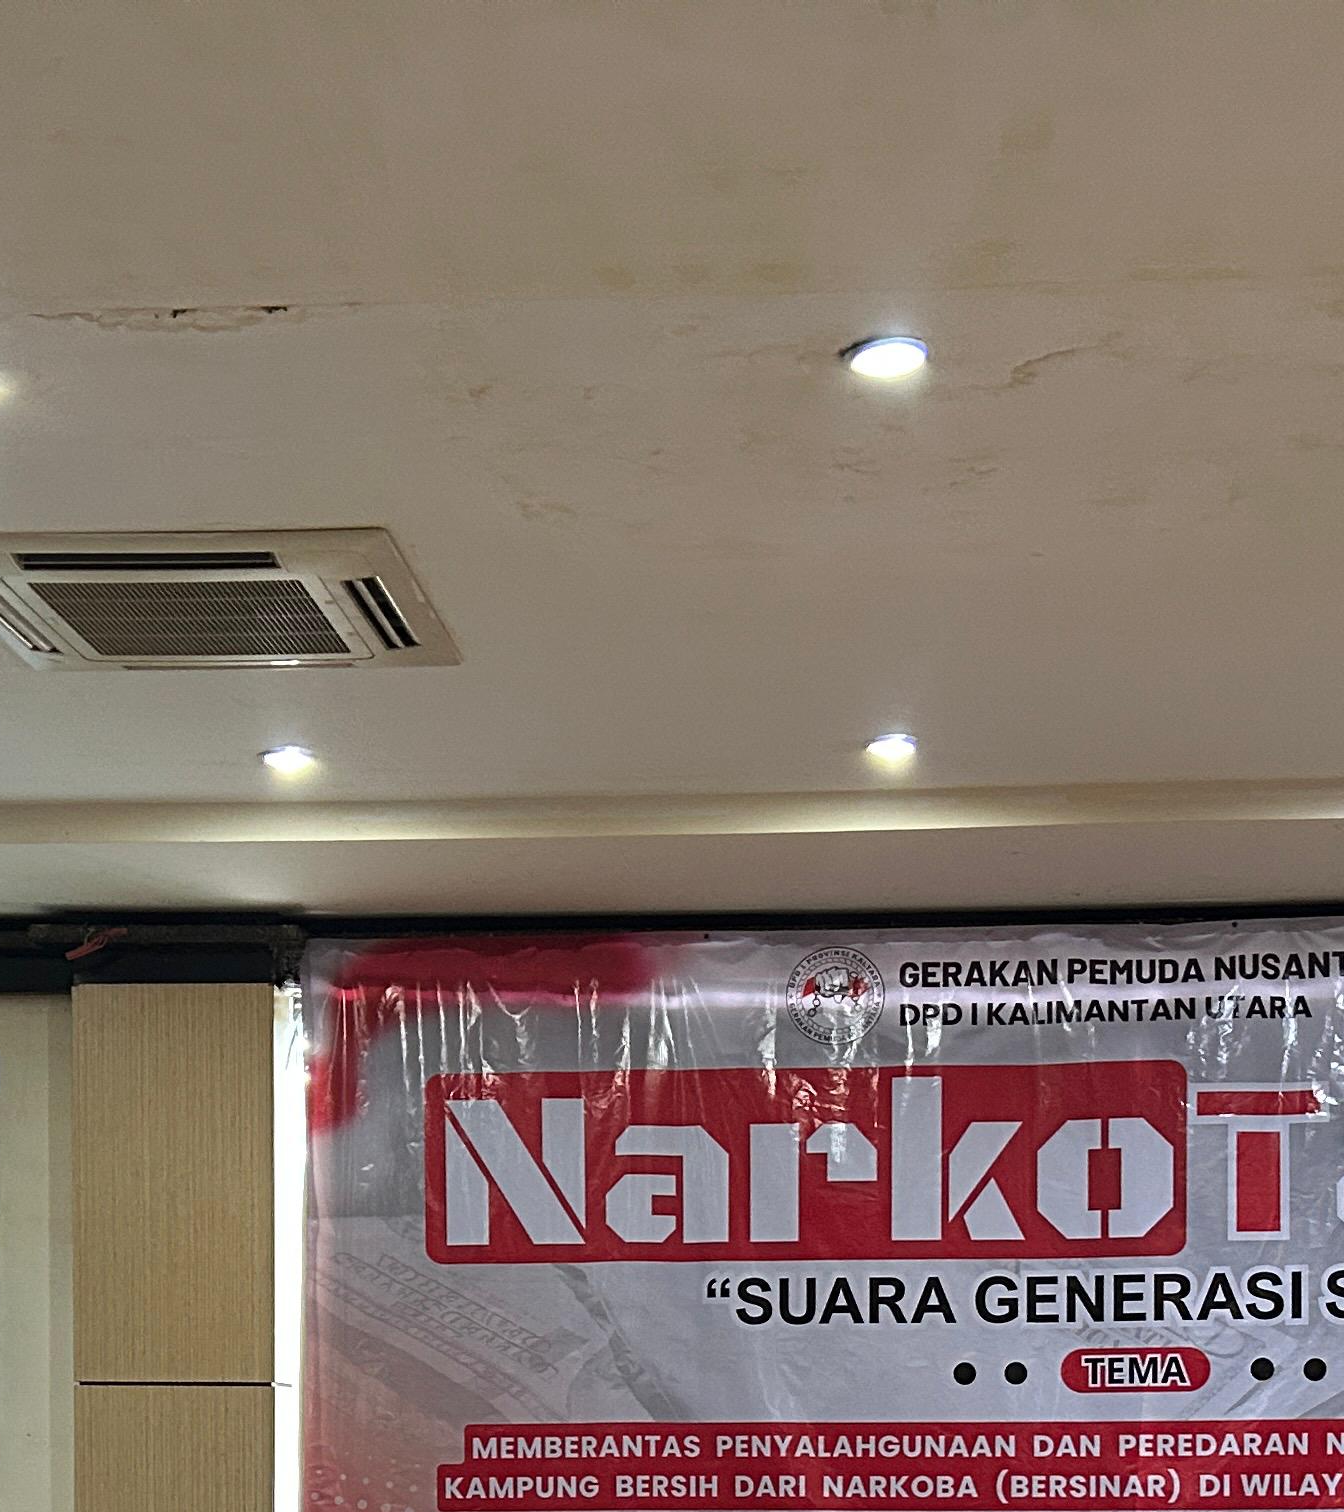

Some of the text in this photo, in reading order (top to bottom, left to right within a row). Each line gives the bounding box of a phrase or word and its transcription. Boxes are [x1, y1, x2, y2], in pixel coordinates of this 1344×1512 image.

[899, 959, 1058, 987] GERAKAN
[1067, 957, 1205, 985] PEMUDA
[899, 1003, 963, 1027] DPD
[971, 1003, 978, 1026] I
[987, 997, 1196, 1026] KALIMANTAN
[1206, 995, 1312, 1020] UTARA
[706, 1275, 957, 1325] “SUARA
[974, 1269, 1303, 1324] GENERASI
[1083, 1354, 1189, 1386] TEMA
[471, 1434, 701, 1460] MEMBERANTAS
[716, 1434, 1016, 1459] PENYALAHGUNAAN
[1033, 1434, 1101, 1458] DAN
[1118, 1433, 1309, 1458] PEREDARAN
[444, 1475, 600, 1500] KAMPUNG
[615, 1475, 718, 1498] BERSIH
[734, 1475, 806, 1498] DARI
[823, 1474, 979, 1499] NARKOBA
[995, 1468, 1181, 1505] (BERSINAR)
[1199, 1473, 1231, 1498] DI
